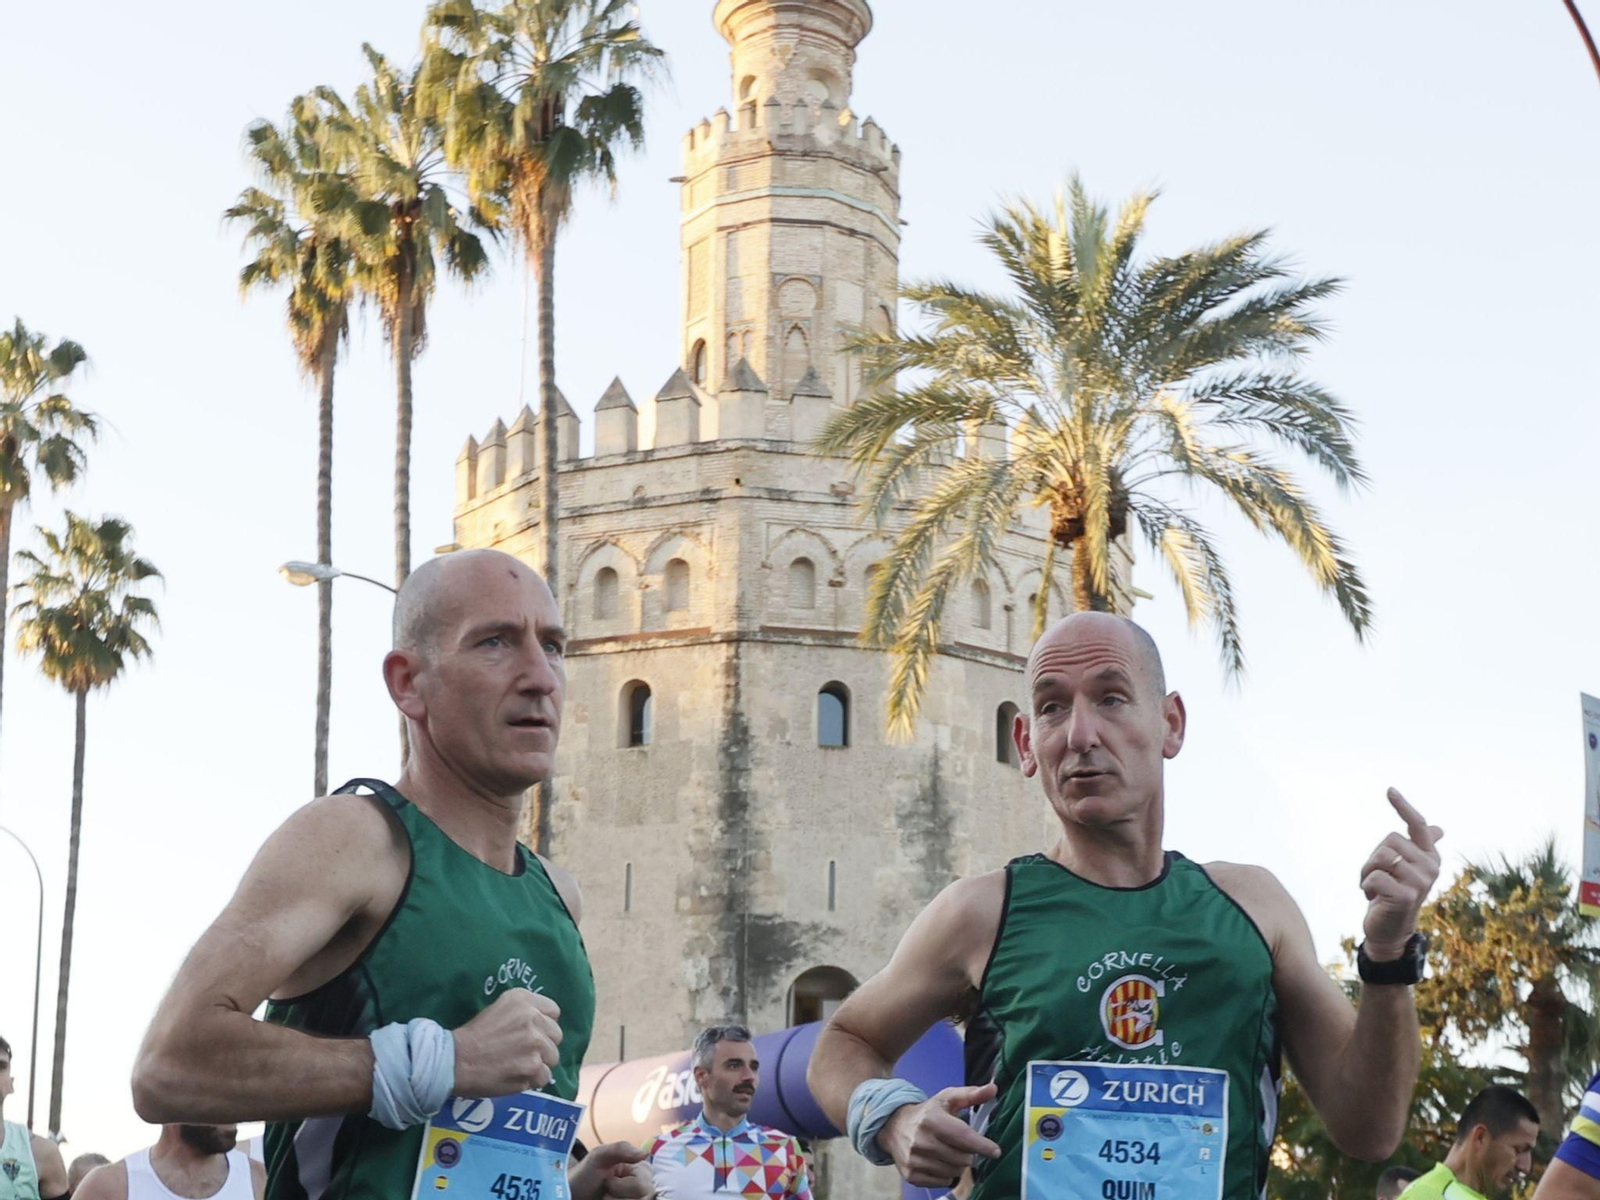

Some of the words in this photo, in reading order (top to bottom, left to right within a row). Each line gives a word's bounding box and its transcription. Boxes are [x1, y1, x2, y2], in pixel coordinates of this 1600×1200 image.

[484, 958, 544, 996] CORNEL
[657, 1069, 704, 1110] asic
[1101, 1080, 1205, 1105] ZURICH
[503, 1106, 569, 1141] ZURICH
[1098, 1139, 1161, 1165] 4534
